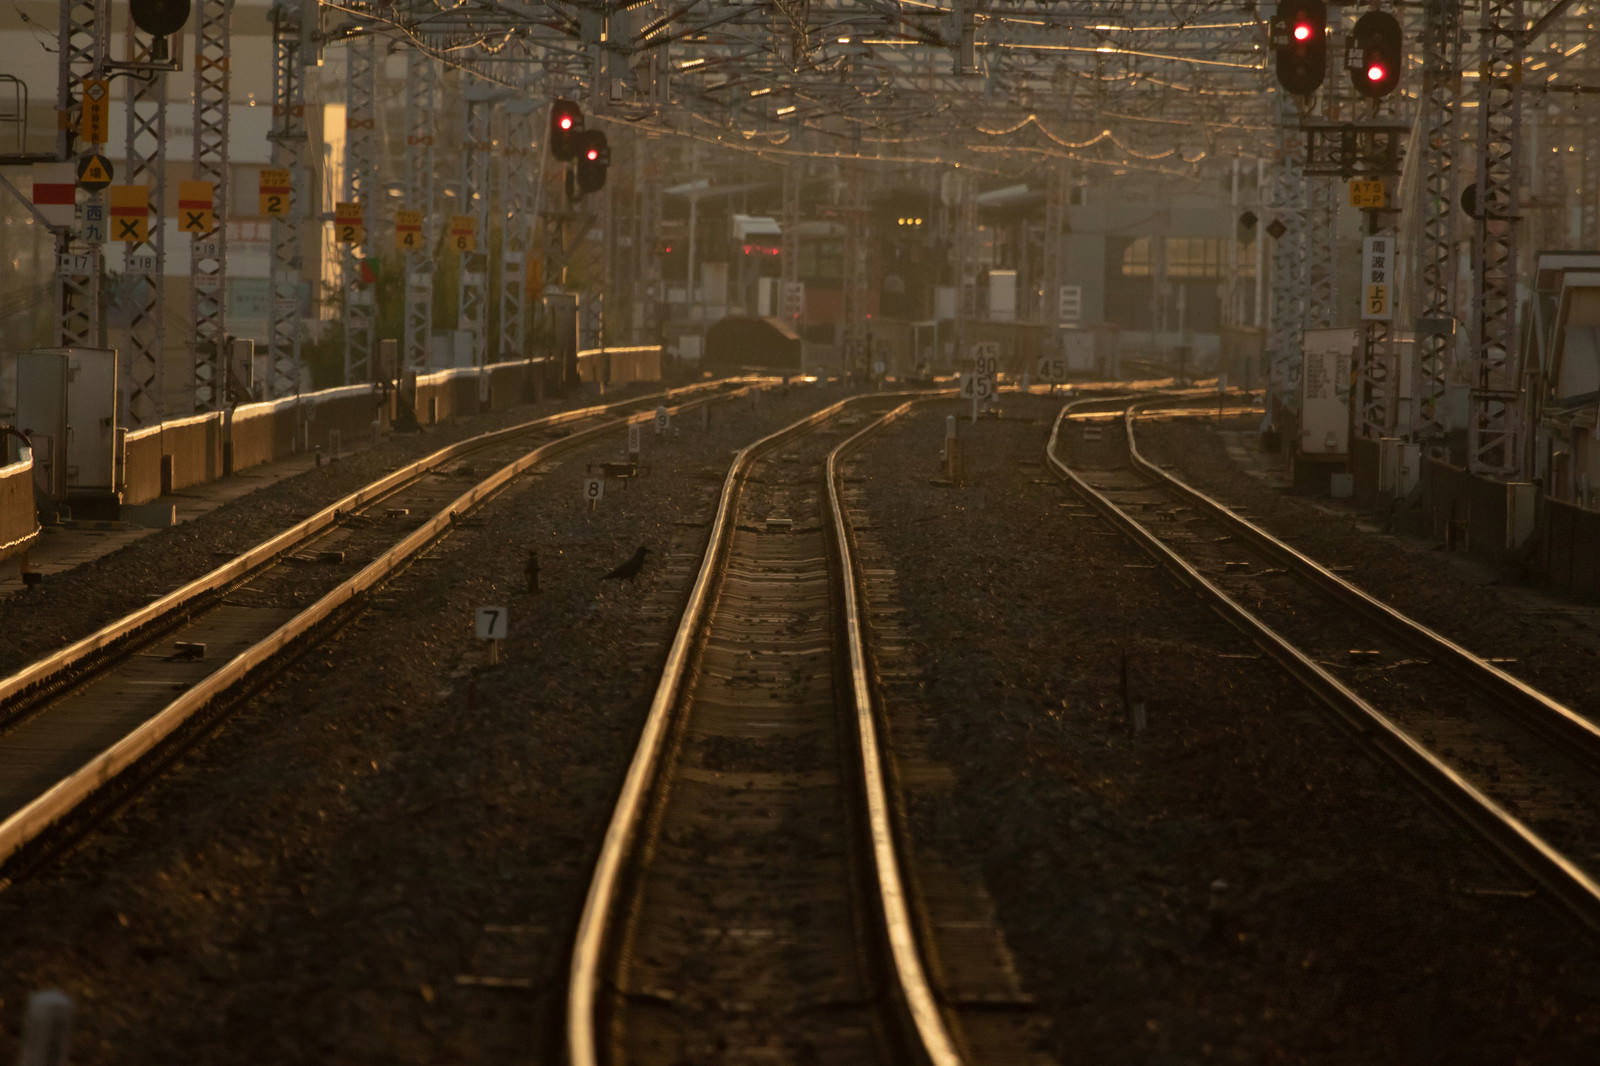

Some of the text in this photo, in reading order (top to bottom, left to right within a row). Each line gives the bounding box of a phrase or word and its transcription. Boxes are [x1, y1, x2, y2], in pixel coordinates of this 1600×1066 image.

[267, 196, 281, 212] 2
[86, 205, 103, 241] 西九
[343, 226, 354, 241] 2
[403, 232, 414, 246] 4
[457, 236, 467, 249] 6
[75, 255, 88, 269] 17
[139, 257, 153, 269] 18
[976, 357, 995, 374] 90
[1040, 359, 1065, 379] 45
[965, 376, 987, 396] 45
[659, 414, 667, 426] 9
[588, 482, 599, 497] 8
[483, 610, 499, 635] 7
